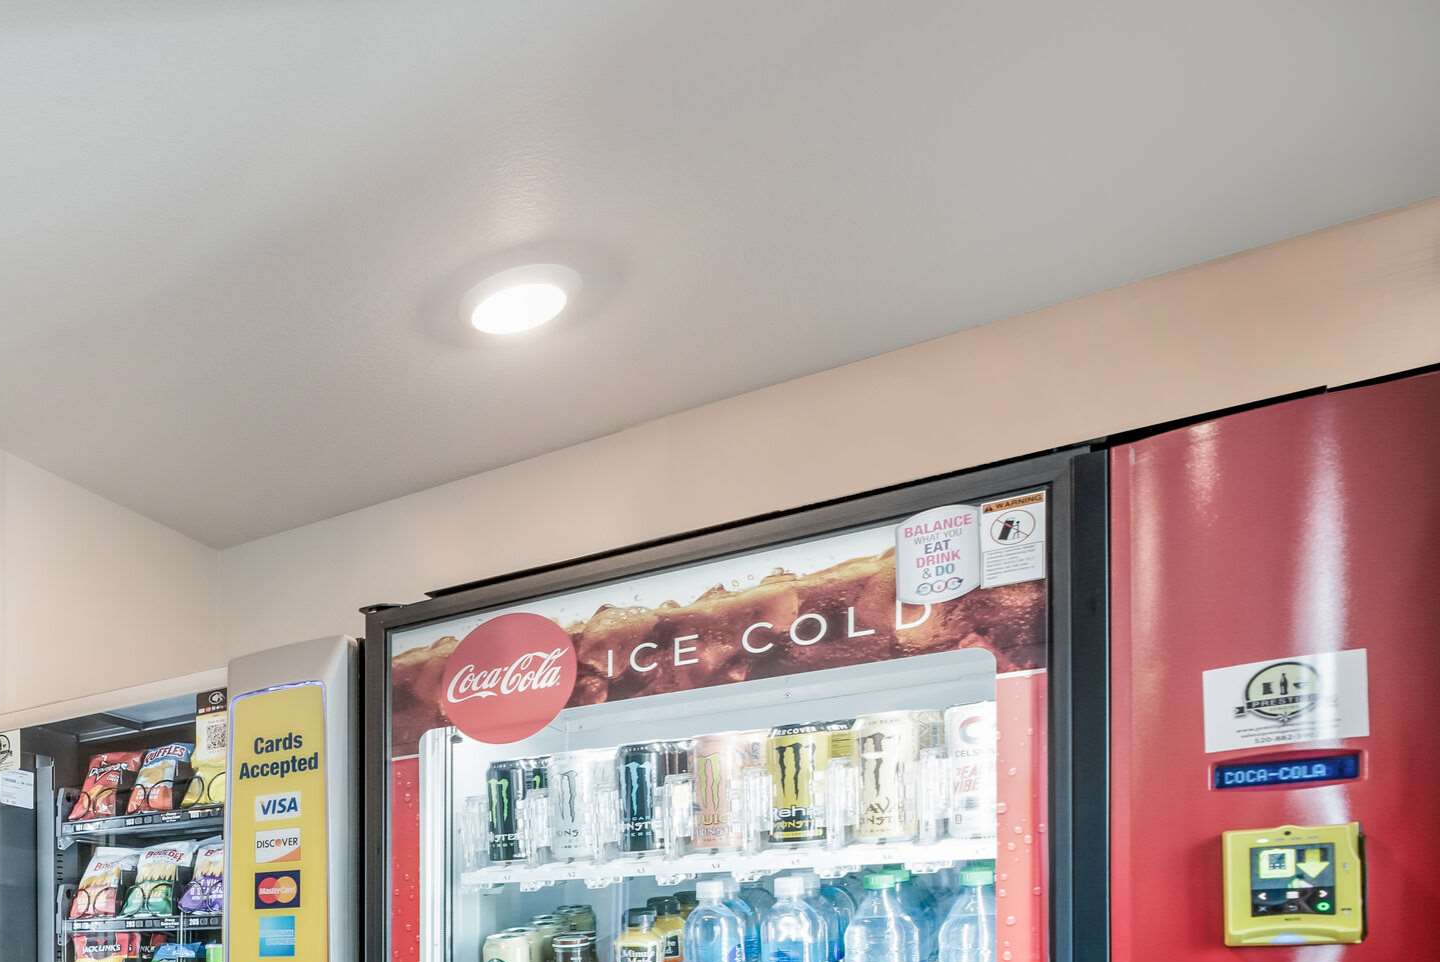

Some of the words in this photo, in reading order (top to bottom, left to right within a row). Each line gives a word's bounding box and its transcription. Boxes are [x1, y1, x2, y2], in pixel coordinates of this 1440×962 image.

[995, 493, 1043, 509] WARNING
[904, 513, 973, 538] BALANCE
[913, 532, 941, 545] WHAT
[942, 528, 962, 538] YOU
[924, 539, 951, 555] EAT
[916, 549, 961, 569] DRINK
[921, 567, 933, 579] &
[935, 563, 955, 577] DO
[607, 633, 699, 678] ICE
[741, 601, 933, 653] COLD
[446, 646, 570, 704] Coca-Cola
[254, 732, 303, 755] Cards
[239, 752, 319, 781] Accepted
[1224, 764, 1326, 785] COCA-COLA
[260, 796, 298, 815] VISA
[256, 837, 298, 849] DISCOVER
